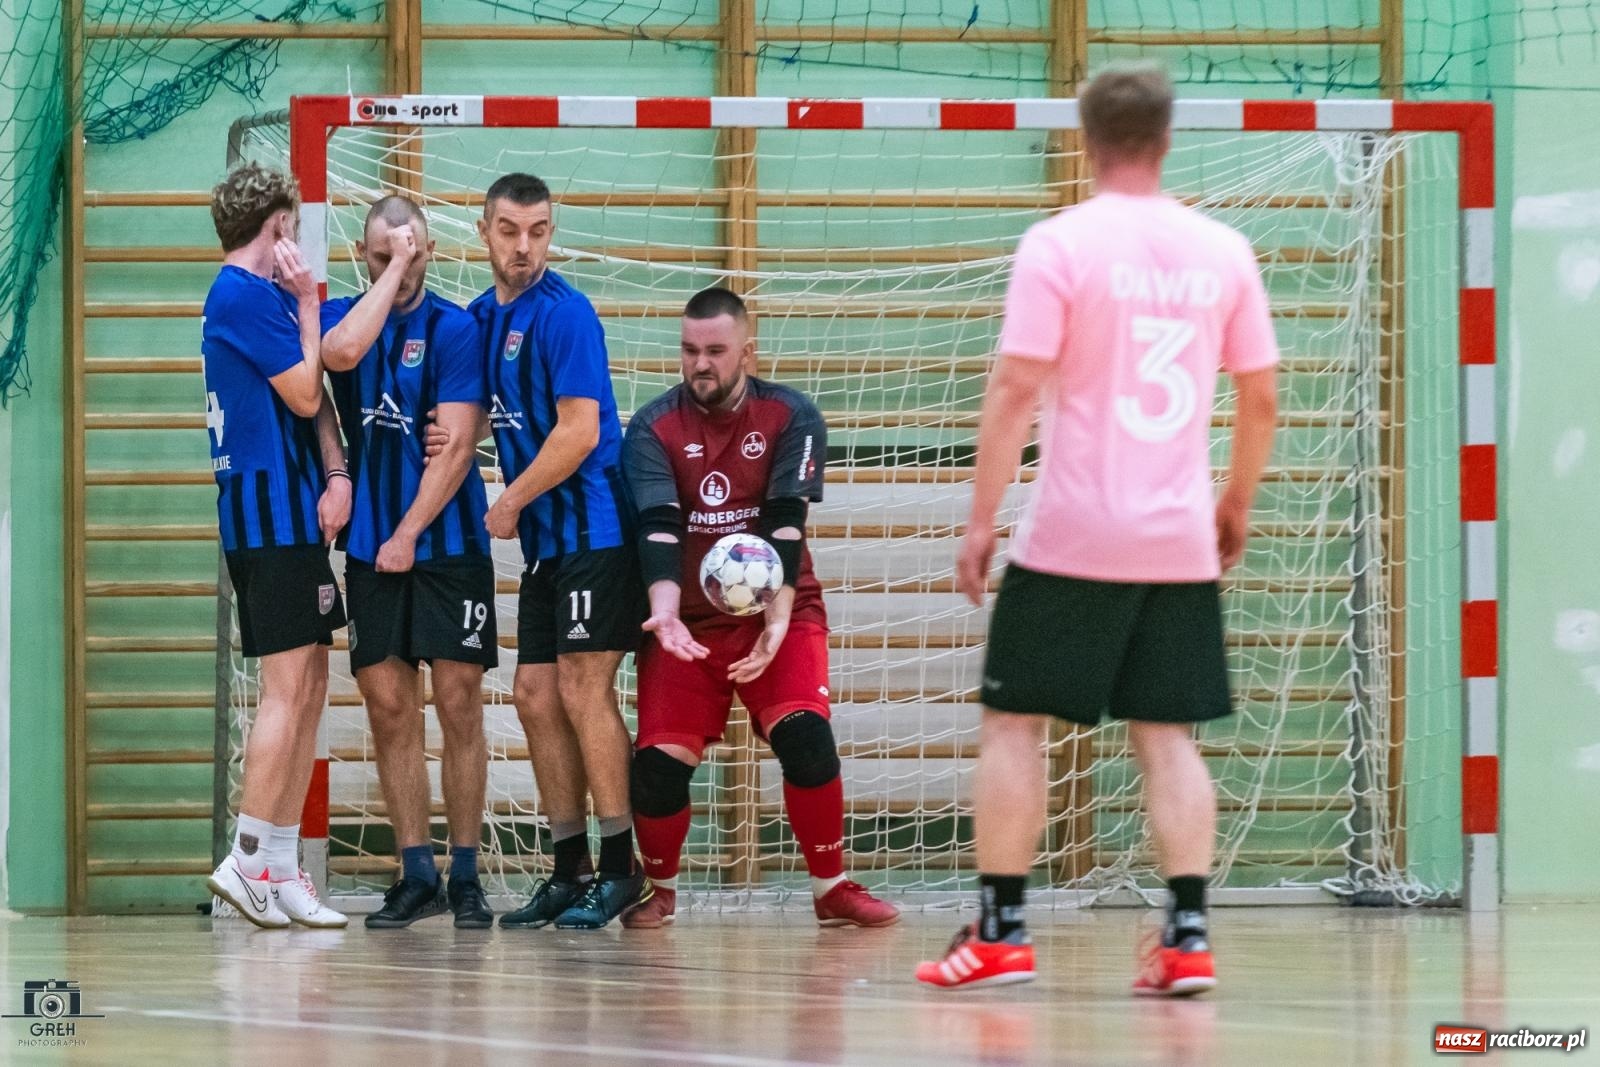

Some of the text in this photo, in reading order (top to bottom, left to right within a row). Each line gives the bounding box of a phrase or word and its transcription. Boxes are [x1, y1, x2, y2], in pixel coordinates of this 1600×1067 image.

[411, 103, 459, 119] sport
[1115, 315, 1197, 441] 3
[463, 600, 488, 632] 19
[569, 590, 592, 621] 11
[567, 632, 590, 640] adidas
